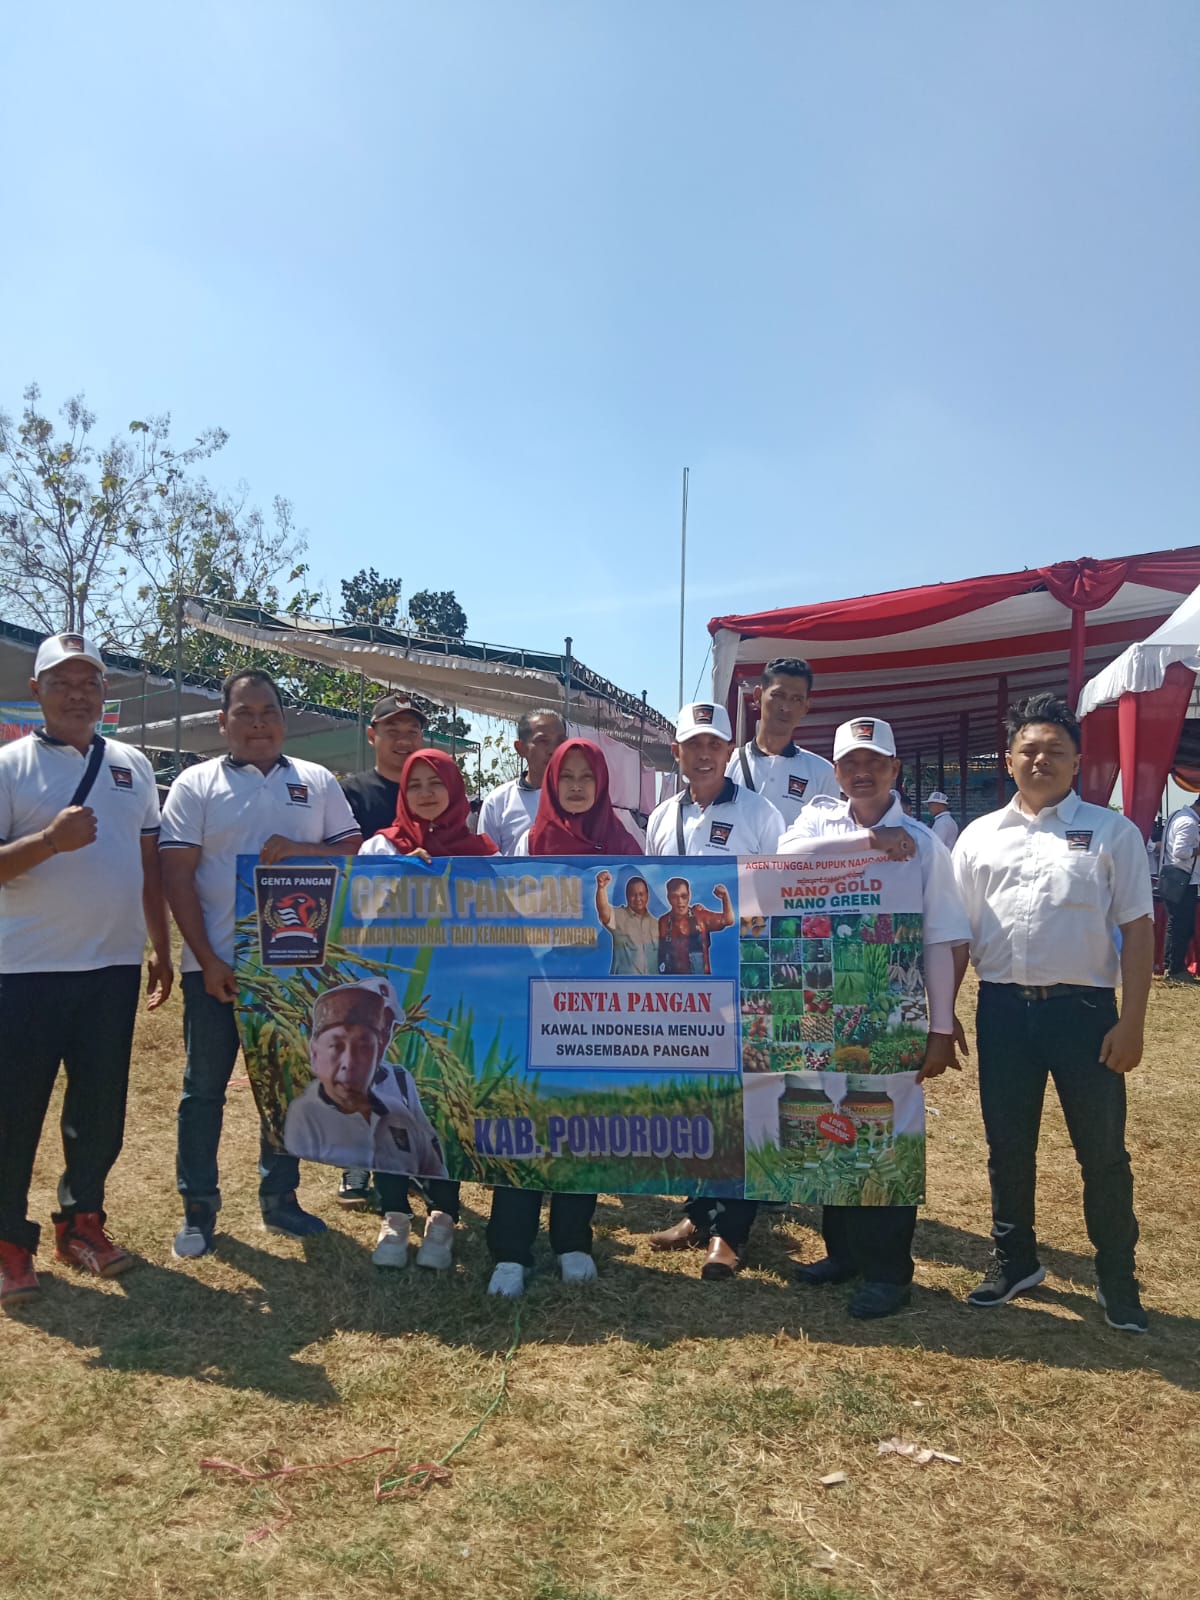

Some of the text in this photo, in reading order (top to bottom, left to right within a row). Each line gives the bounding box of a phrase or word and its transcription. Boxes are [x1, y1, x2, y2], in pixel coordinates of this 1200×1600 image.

[745, 862, 769, 870] AGEN
[772, 861, 814, 871] TUNGGAL
[816, 860, 846, 870] PUPUK
[261, 877, 331, 886] GENTA PANGAN
[781, 879, 882, 897] NANO GOLD
[455, 875, 583, 919] PANGAN
[784, 894, 880, 909] NANO GREEN
[553, 992, 712, 1013] GENTA PANGAN
[541, 1023, 725, 1037] KAWAL INDONESIA MENUJU
[556, 1044, 709, 1057] SWASEMBADA PANGAN
[474, 1114, 714, 1160] KAB. PONOROGO
